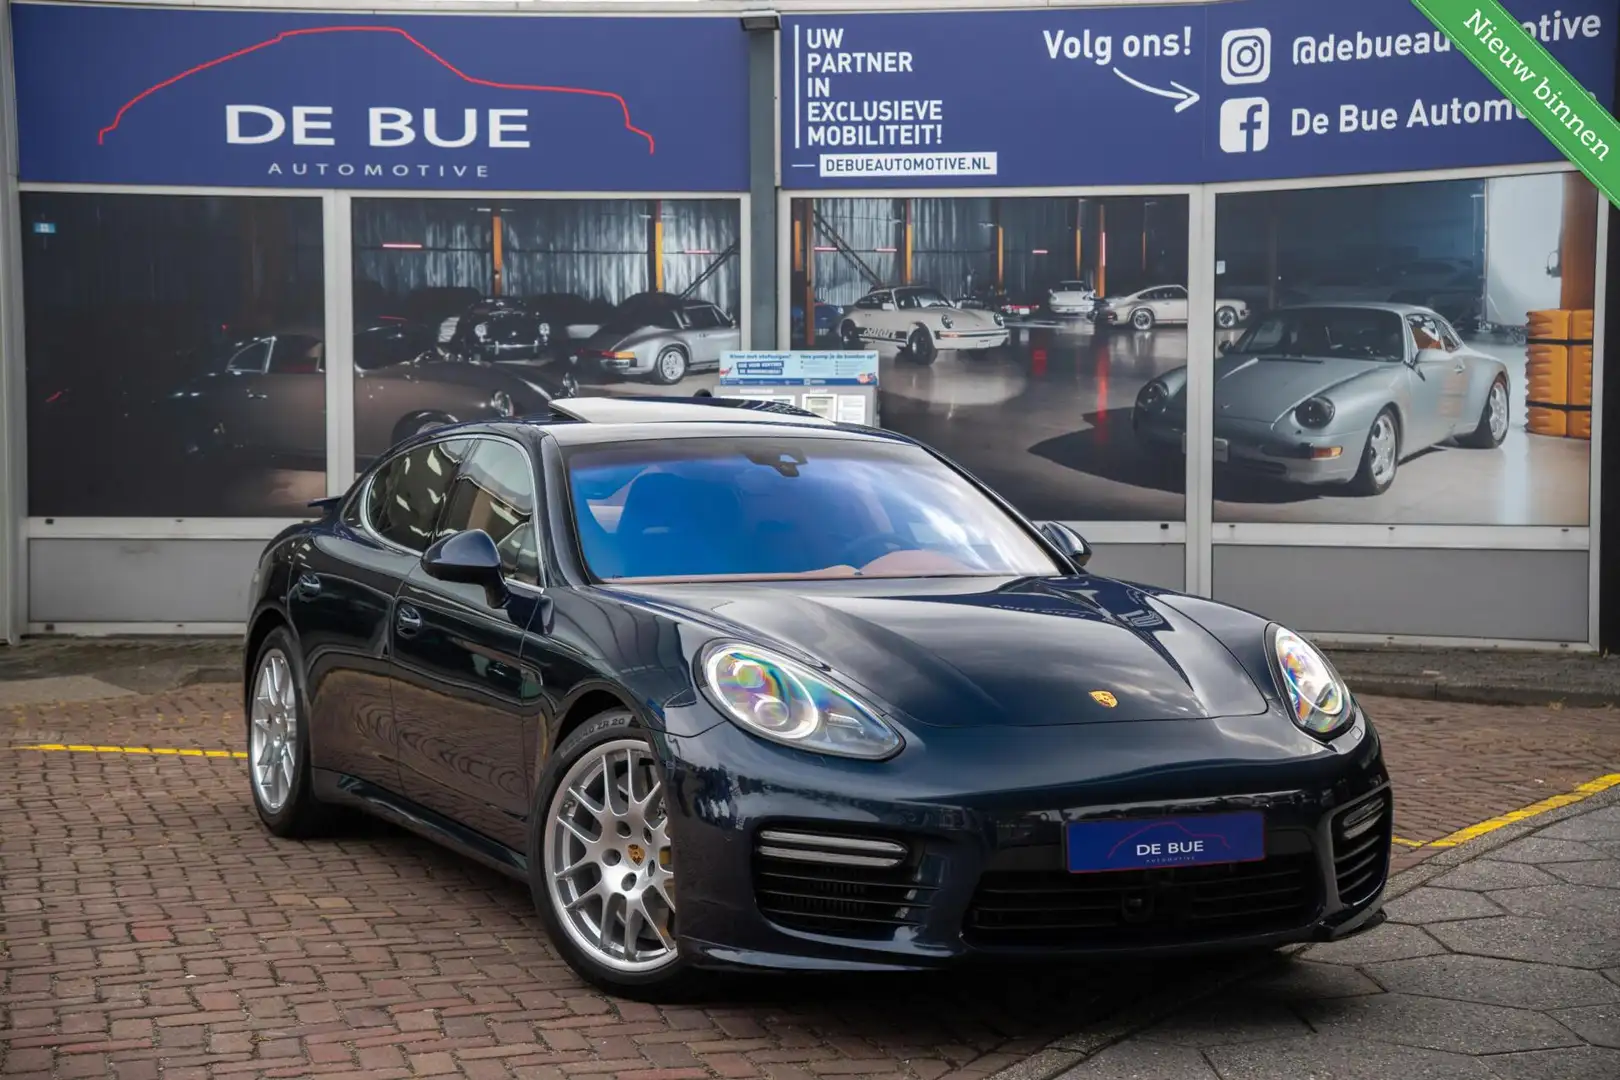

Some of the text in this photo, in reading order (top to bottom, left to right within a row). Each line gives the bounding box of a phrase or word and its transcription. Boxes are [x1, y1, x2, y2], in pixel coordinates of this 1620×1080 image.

[806, 27, 844, 49] UW
[1042, 26, 1192, 66] Volg ons!
[1292, 9, 1602, 66] @debueauotive
[806, 51, 913, 73] PARTNER
[806, 77, 830, 98] IN
[806, 100, 943, 122] EXCLUSIEVE
[1291, 108, 1330, 137] De
[1339, 103, 1398, 133] Bue
[225, 104, 531, 148] DE BUE
[806, 124, 943, 146] MOBILITEIT!
[268, 162, 489, 178] AUTOMOTIVE
[825, 157, 992, 172] DEBUEAUTOMOTIVE.NL
[1136, 840, 1204, 856] DE BUE
